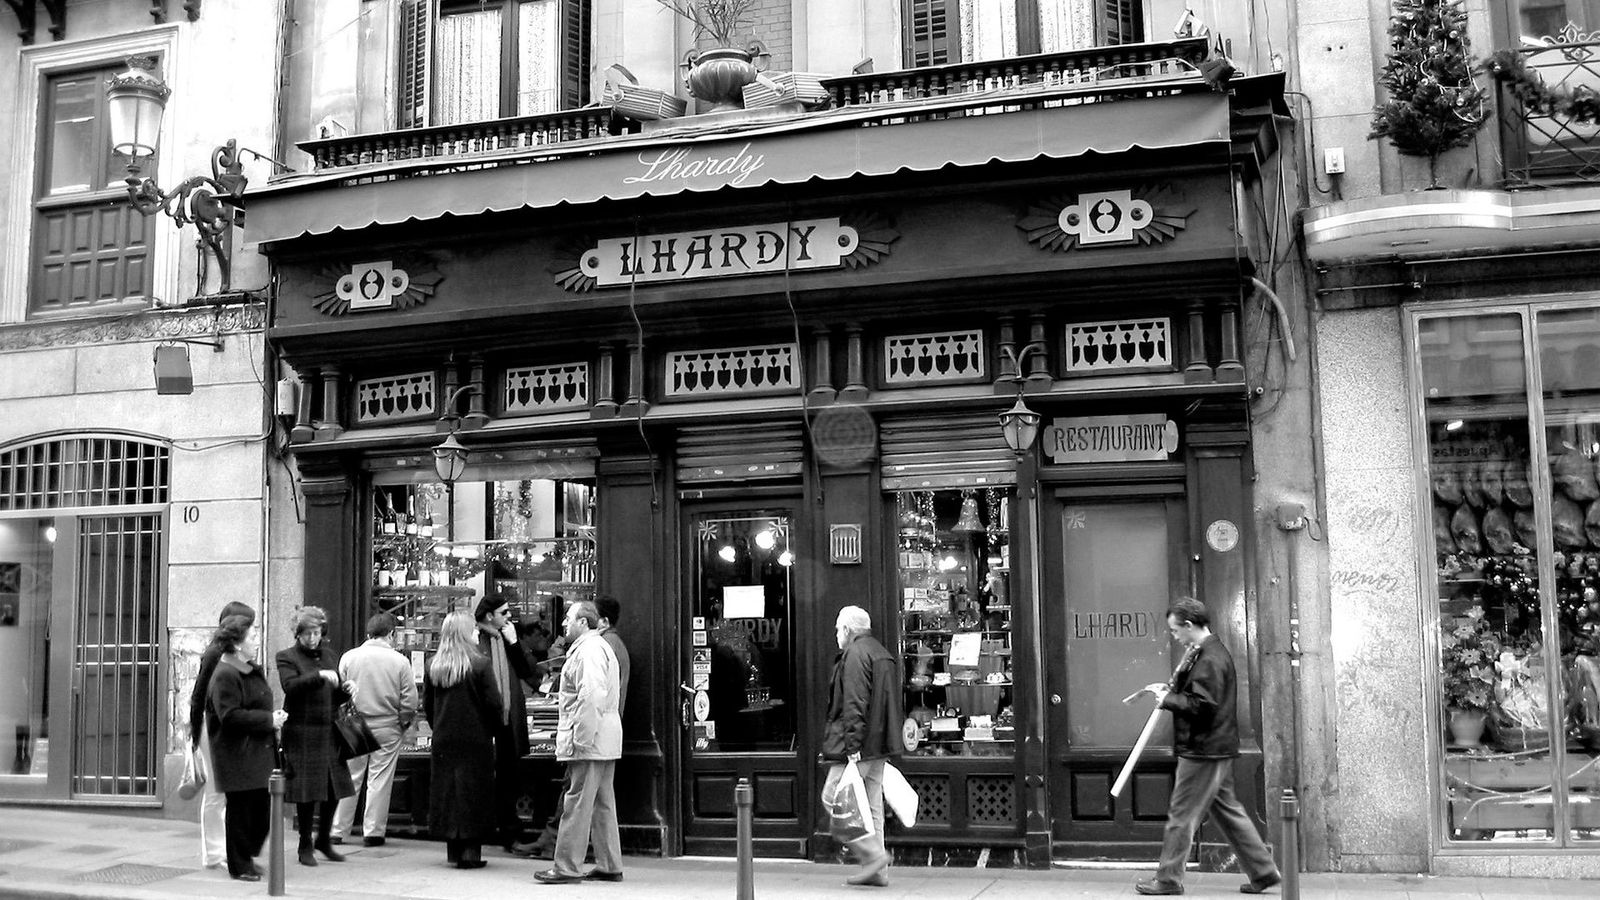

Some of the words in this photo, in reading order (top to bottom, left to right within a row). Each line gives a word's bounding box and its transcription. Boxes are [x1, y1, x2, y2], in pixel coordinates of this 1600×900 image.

[623, 143, 764, 185] Lhardy
[1088, 197, 1122, 235] 8
[619, 225, 817, 278] LHARDY
[358, 268, 386, 301] 8
[1054, 424, 1168, 453] RESTAURANT
[183, 505, 200, 524] 10
[730, 617, 783, 643] ARDY
[1074, 612, 1162, 639] LHARDY
